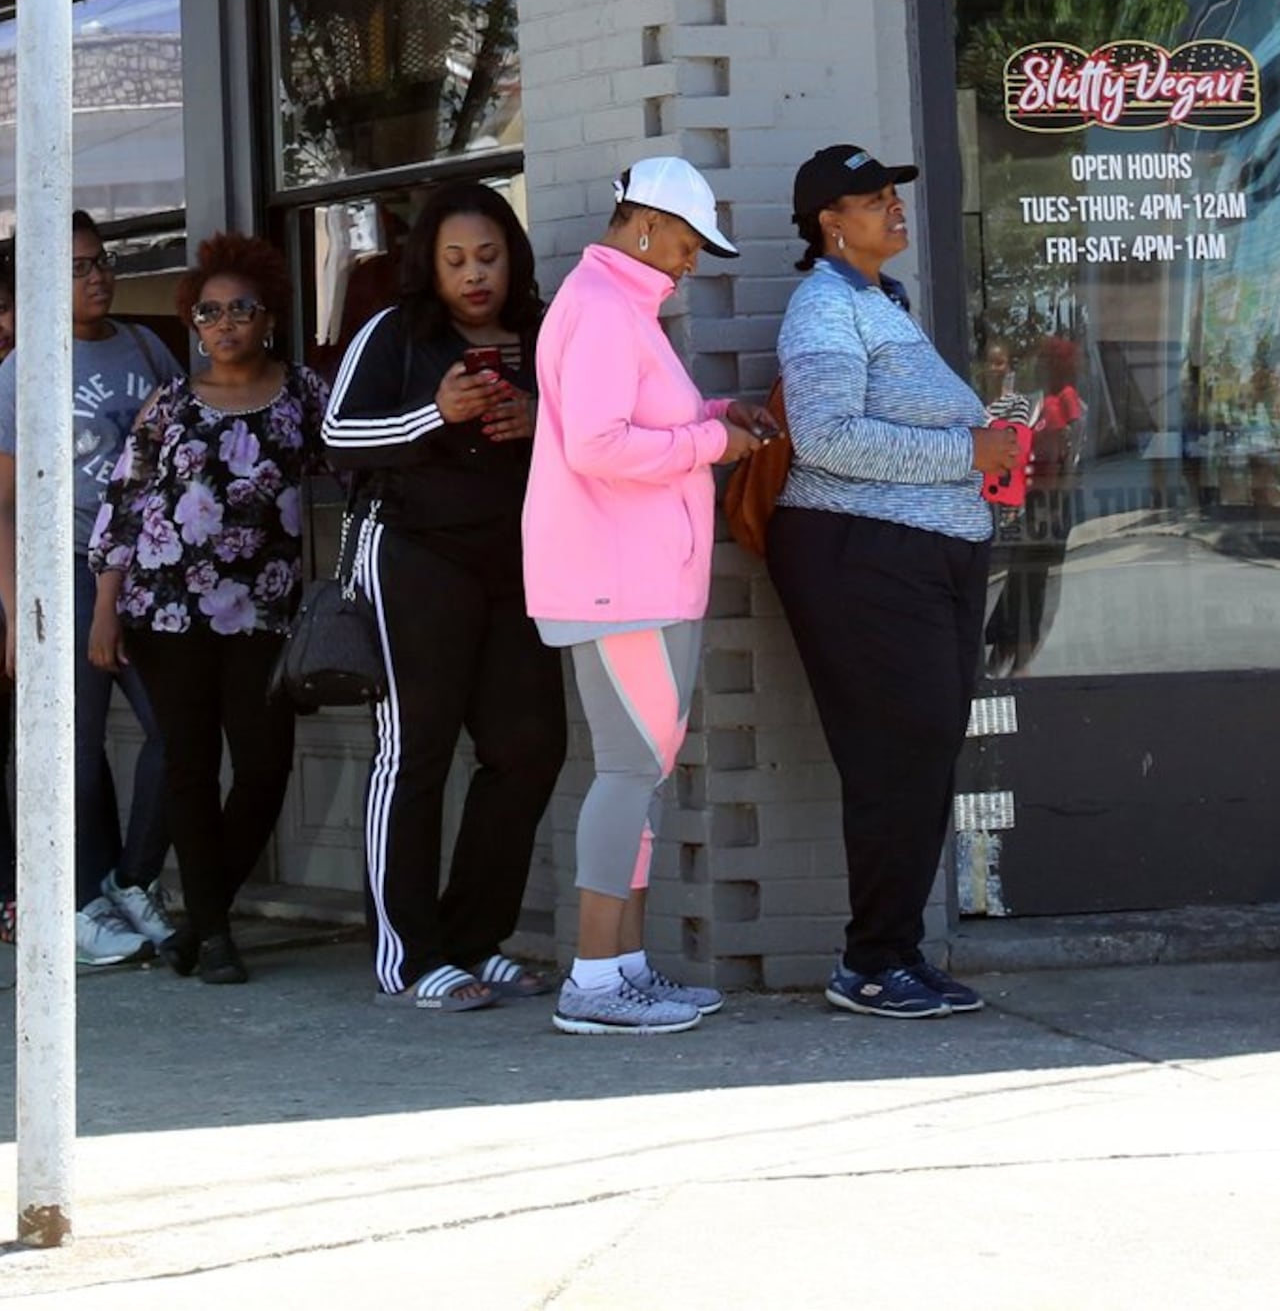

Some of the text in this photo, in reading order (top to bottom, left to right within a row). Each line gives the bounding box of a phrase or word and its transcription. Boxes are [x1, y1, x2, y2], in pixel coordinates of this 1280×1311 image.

[1017, 49, 1246, 123] Slutty Vegan
[1071, 153, 1193, 181] OPEN HOURS
[1020, 192, 1248, 224] TUES-THUR: 4PM-12AM
[1045, 233, 1227, 264] FRI-SAT: 4PM-1AM
